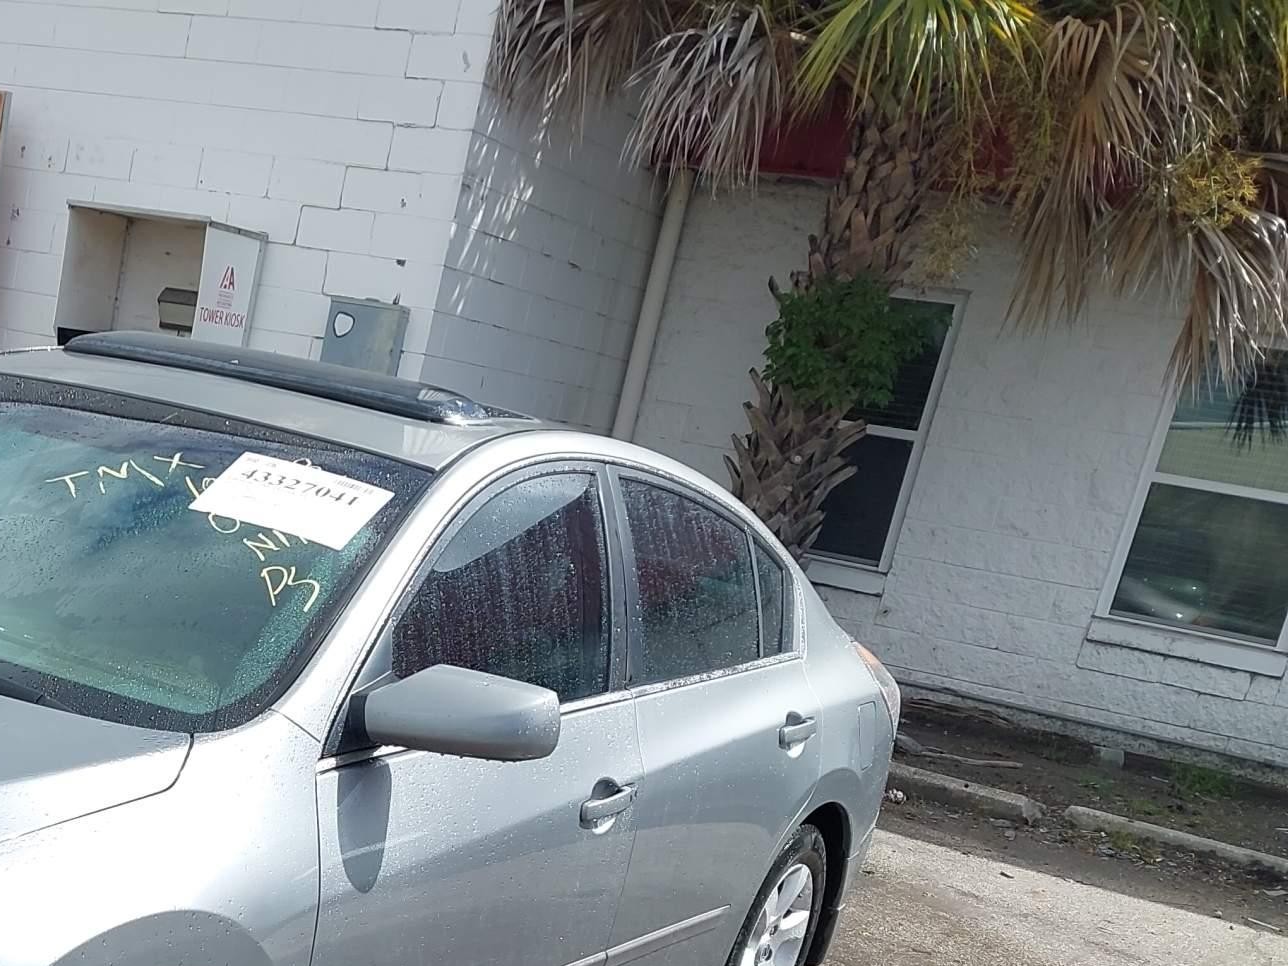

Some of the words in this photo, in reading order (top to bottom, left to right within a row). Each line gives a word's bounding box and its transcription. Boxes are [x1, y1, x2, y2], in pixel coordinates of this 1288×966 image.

[199, 306, 224, 325] TOWER
[224, 312, 245, 328] KIOSK
[240, 468, 361, 507] 43327041
